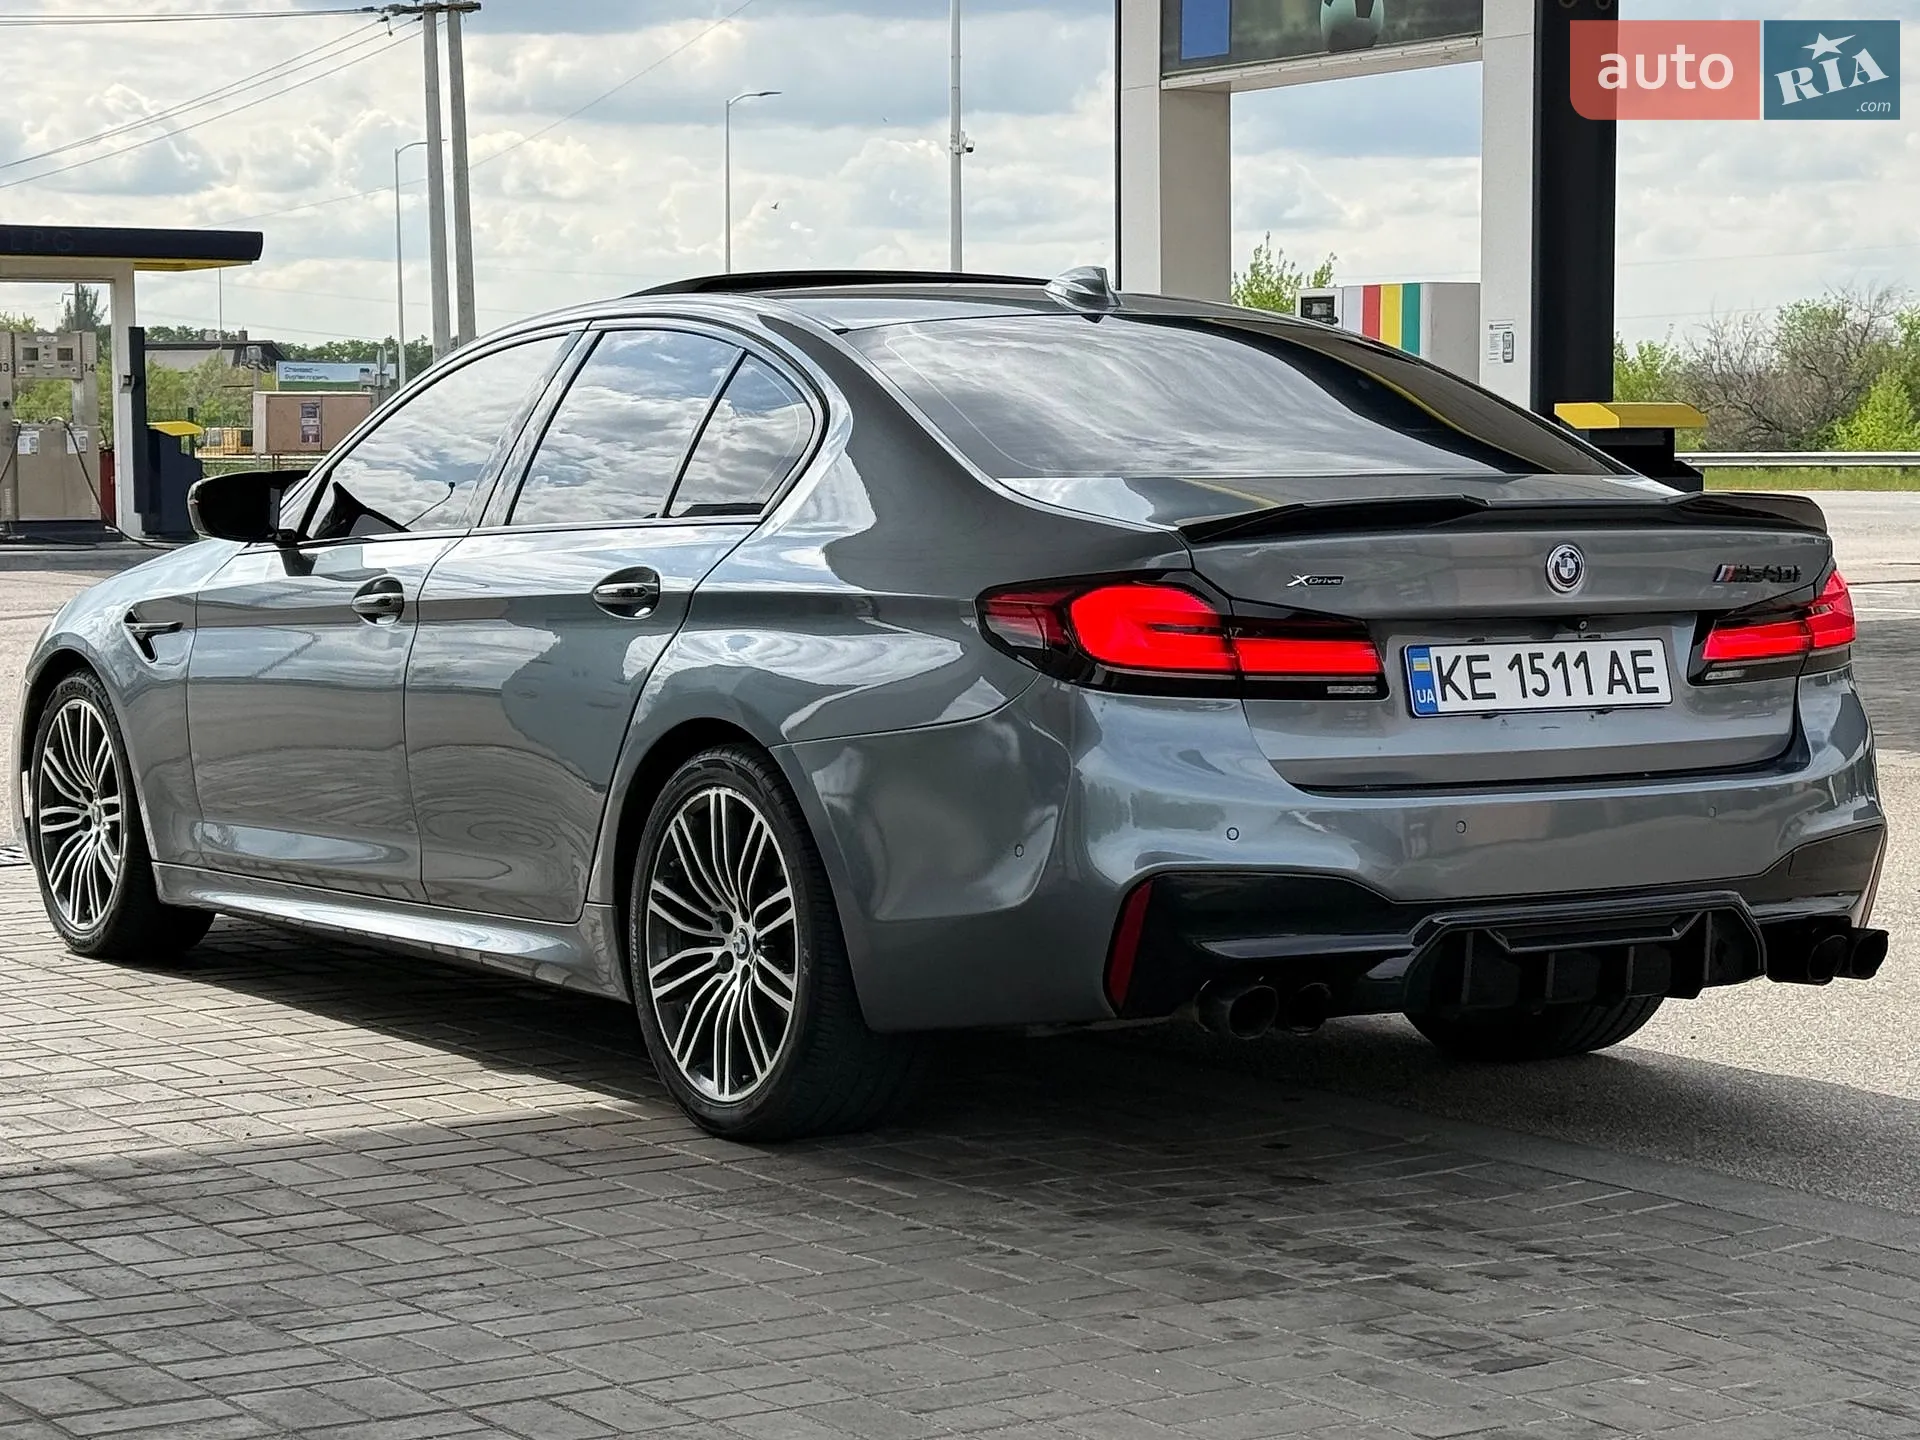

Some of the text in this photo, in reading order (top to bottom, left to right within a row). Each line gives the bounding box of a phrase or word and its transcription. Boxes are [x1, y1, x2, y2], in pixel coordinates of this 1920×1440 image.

[84, 363, 97, 373] 14
[1436, 649, 1660, 702] KE 1511 AE
[1417, 689, 1436, 704] UA
